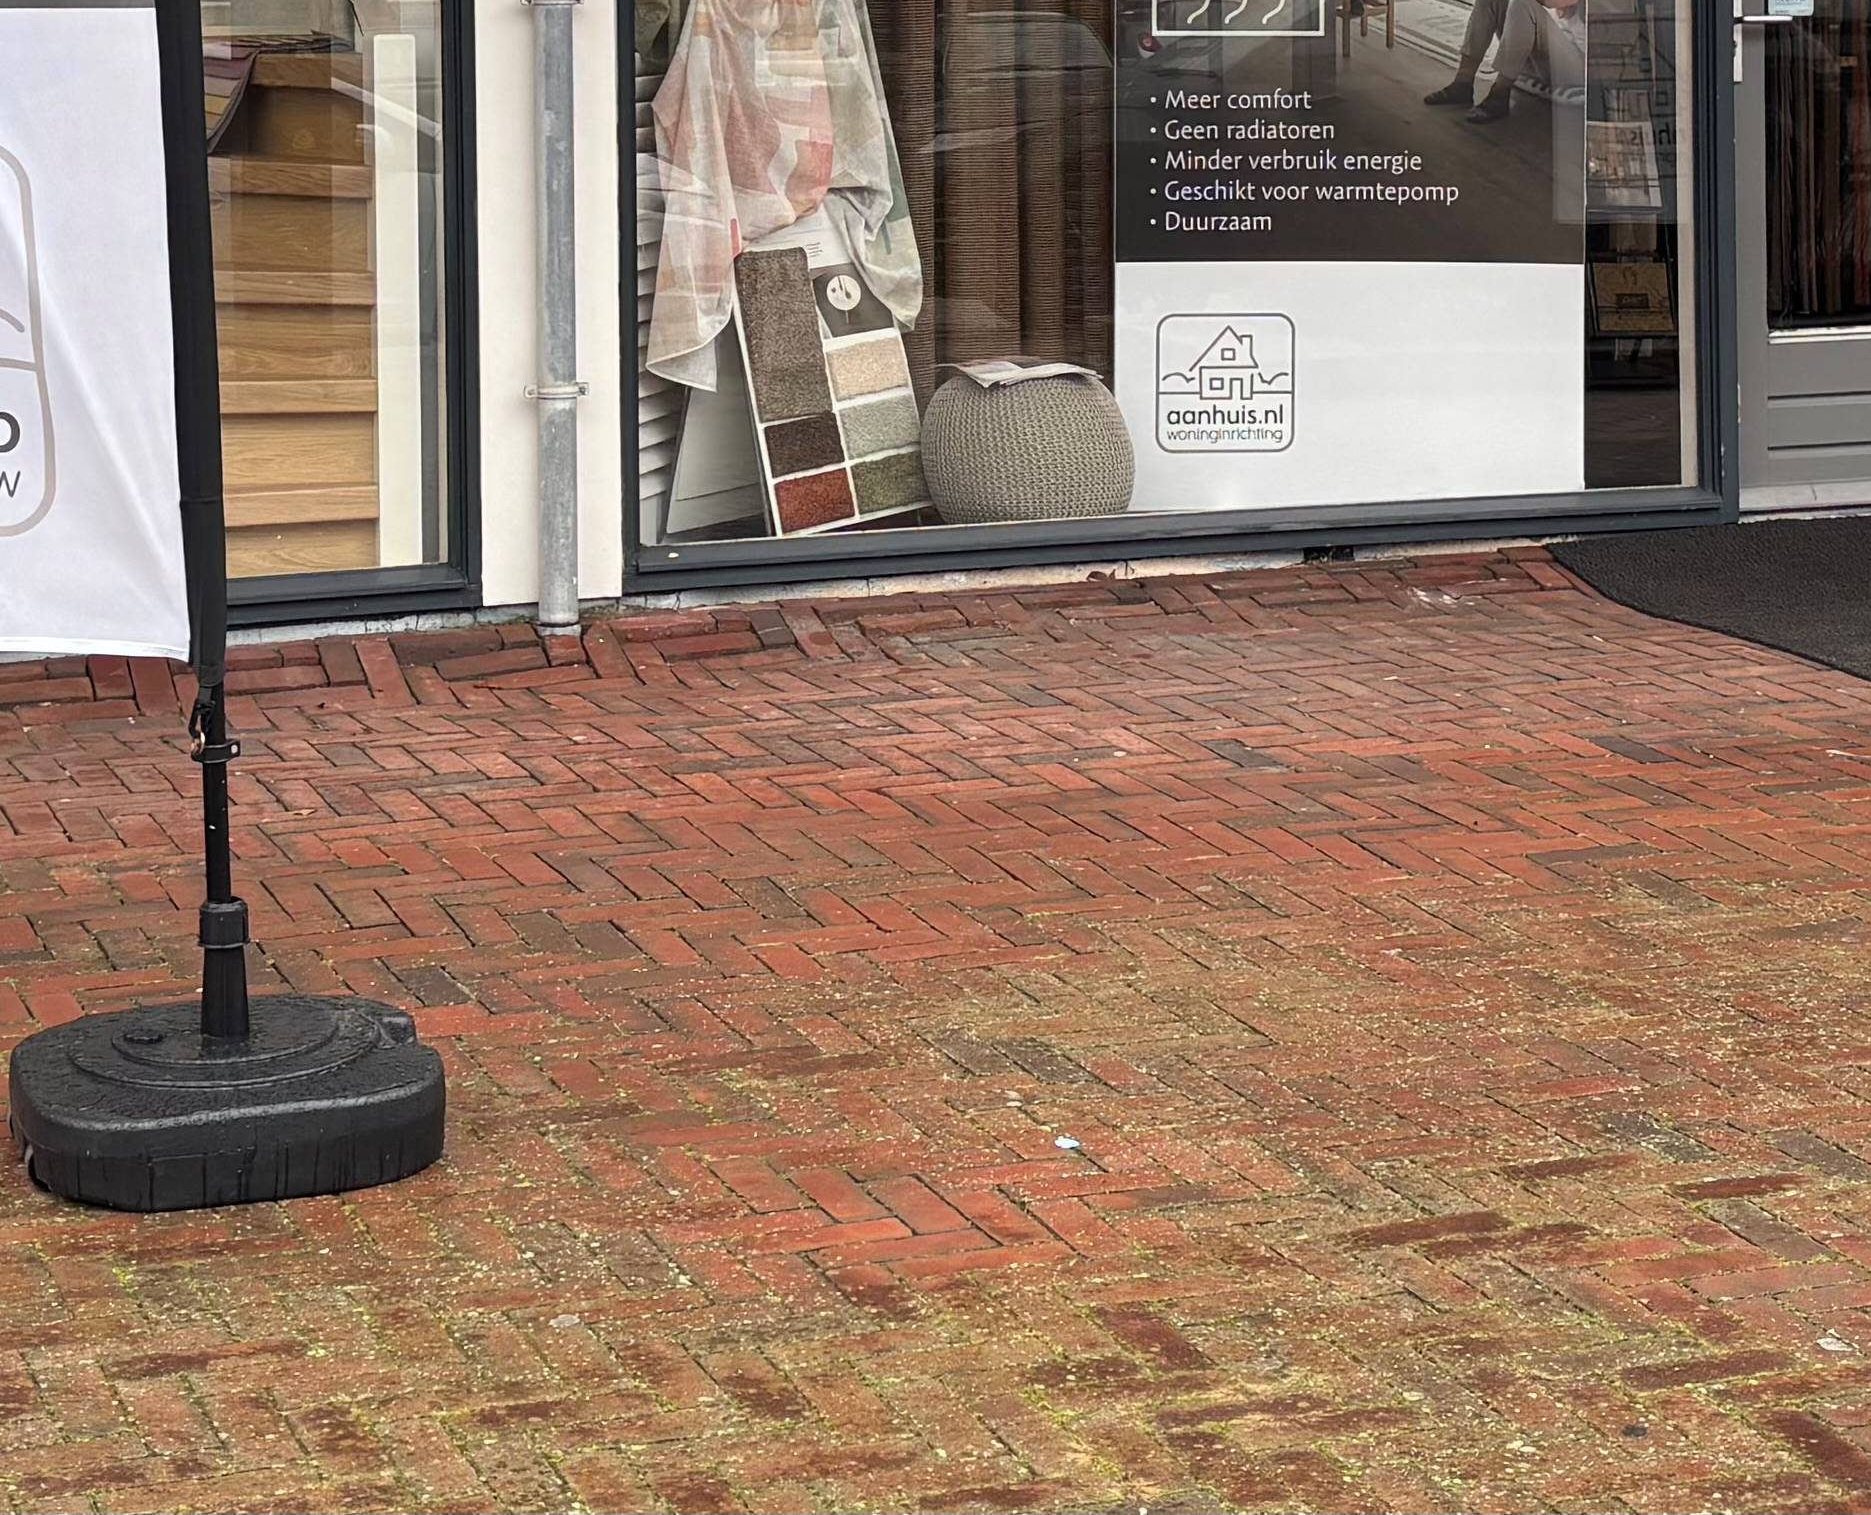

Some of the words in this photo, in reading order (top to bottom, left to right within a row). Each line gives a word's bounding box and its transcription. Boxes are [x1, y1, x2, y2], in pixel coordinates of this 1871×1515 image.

[1165, 90, 1221, 110] Meer
[1227, 88, 1312, 110] comfort
[1165, 120, 1219, 140] Geen
[1227, 118, 1335, 140] radiatoren
[1165, 149, 1243, 170] Minder
[1248, 148, 1337, 170] verbruik
[1343, 150, 1423, 174] energie
[1164, 179, 1256, 201] Geschikt
[1261, 184, 1309, 201] voor
[1315, 183, 1460, 205] warmtepomp
[1165, 211, 1272, 231] Duurzaam
[1166, 403, 1284, 426] aanhuis.nl
[1166, 426, 1284, 444] woninginrichting
